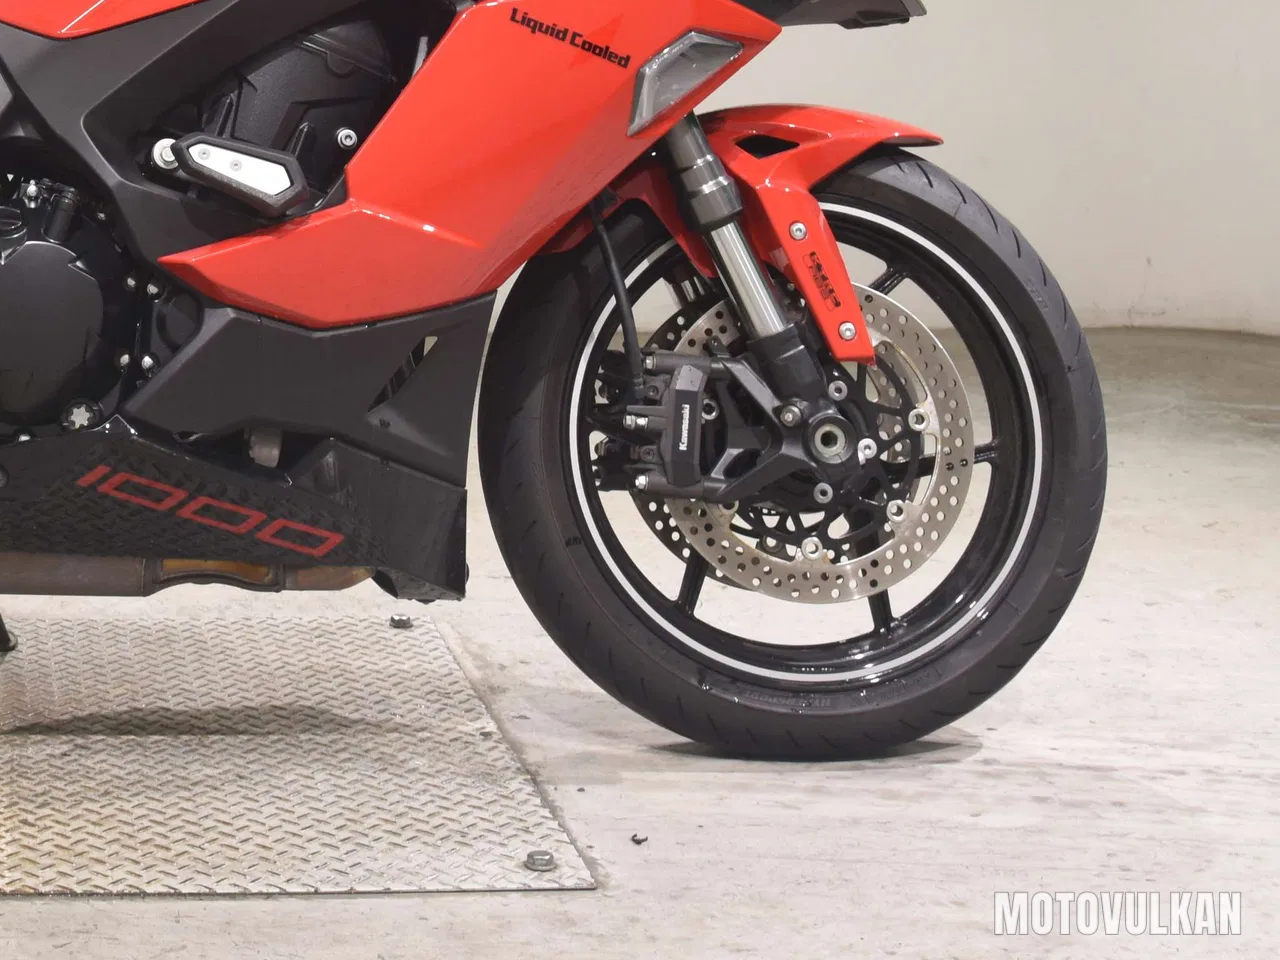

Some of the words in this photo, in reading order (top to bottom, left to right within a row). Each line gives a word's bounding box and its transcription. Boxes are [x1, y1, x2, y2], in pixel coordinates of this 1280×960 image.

[509, 7, 569, 42] Liquid
[569, 31, 631, 69] Cooled
[679, 404, 690, 451] Kawasaki
[76, 465, 345, 558] 1000
